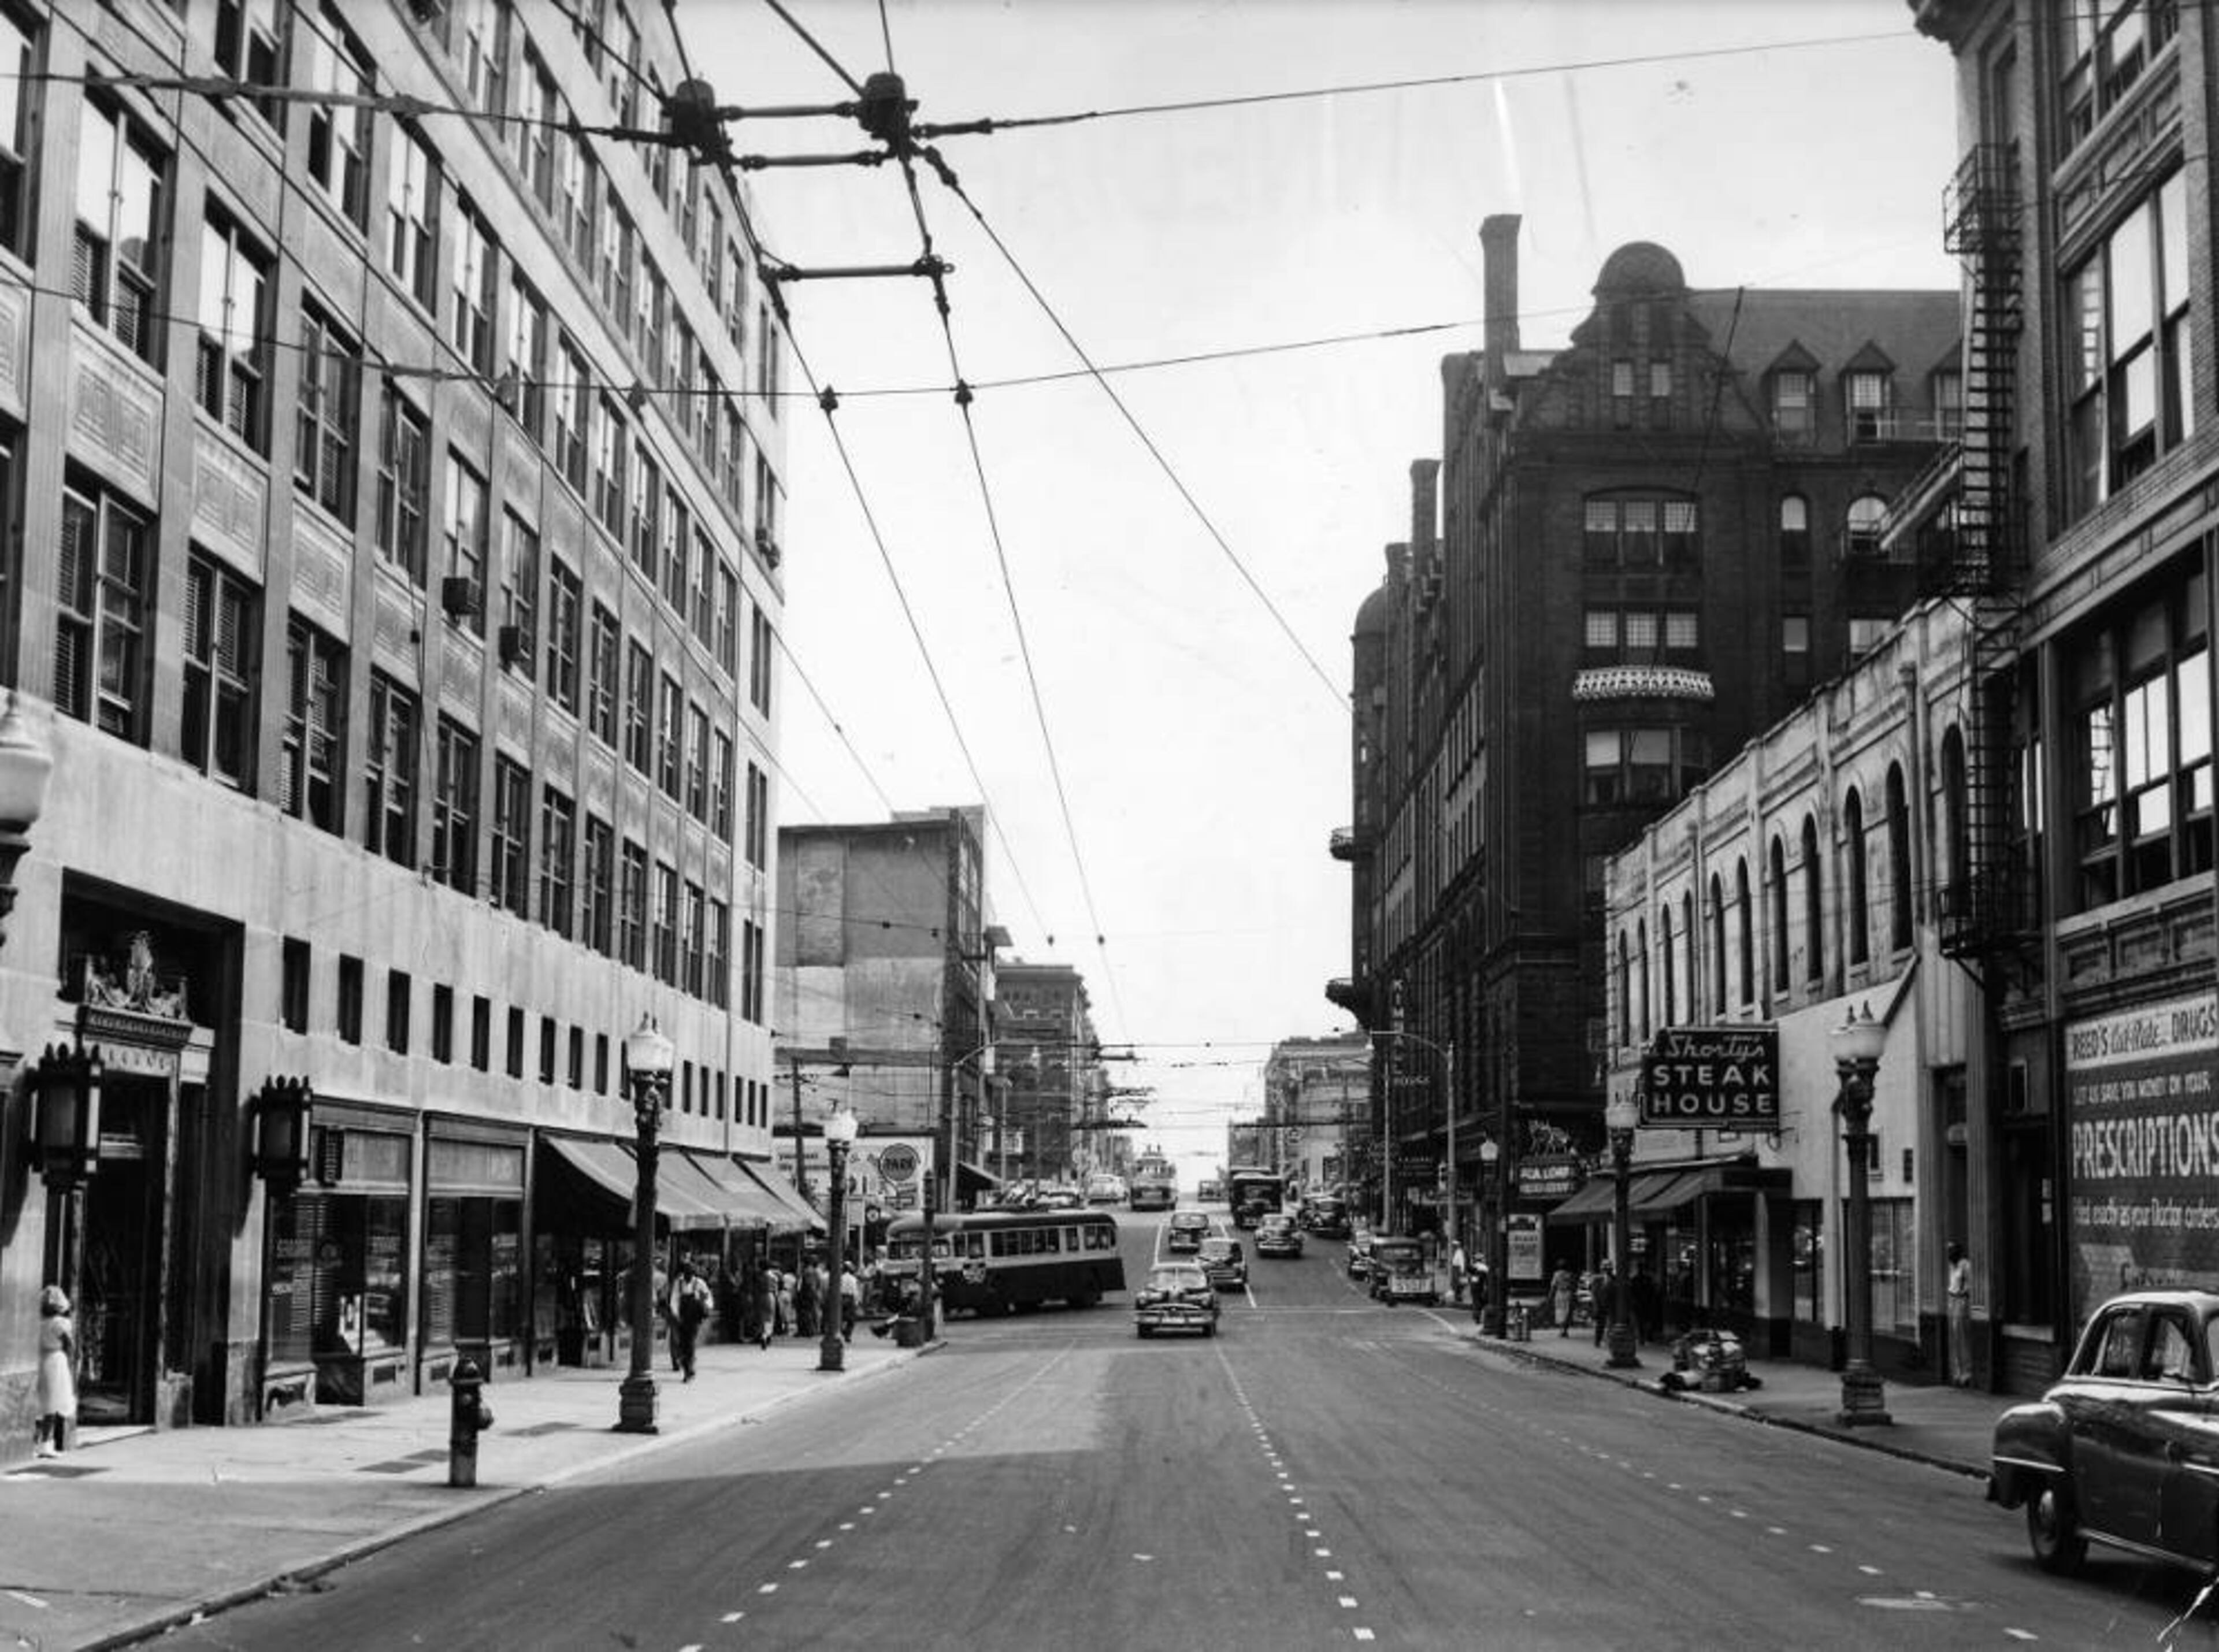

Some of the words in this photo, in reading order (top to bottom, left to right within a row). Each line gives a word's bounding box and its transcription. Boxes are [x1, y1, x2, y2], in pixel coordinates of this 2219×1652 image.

[2073, 1023, 2109, 1061] REED'S
[2171, 1003, 2216, 1043] DRUGS
[1653, 1064, 1770, 1086] STEAK
[2101, 1082, 2120, 1102] SAVE
[2120, 1080, 2136, 1100] YOU
[2169, 1074, 2182, 1095] ON
[1653, 1093, 1773, 1114] HOUSE
[2072, 1111, 2219, 1180] PRESCRIPTIONS
[2151, 1197, 2182, 1226] Doctor
